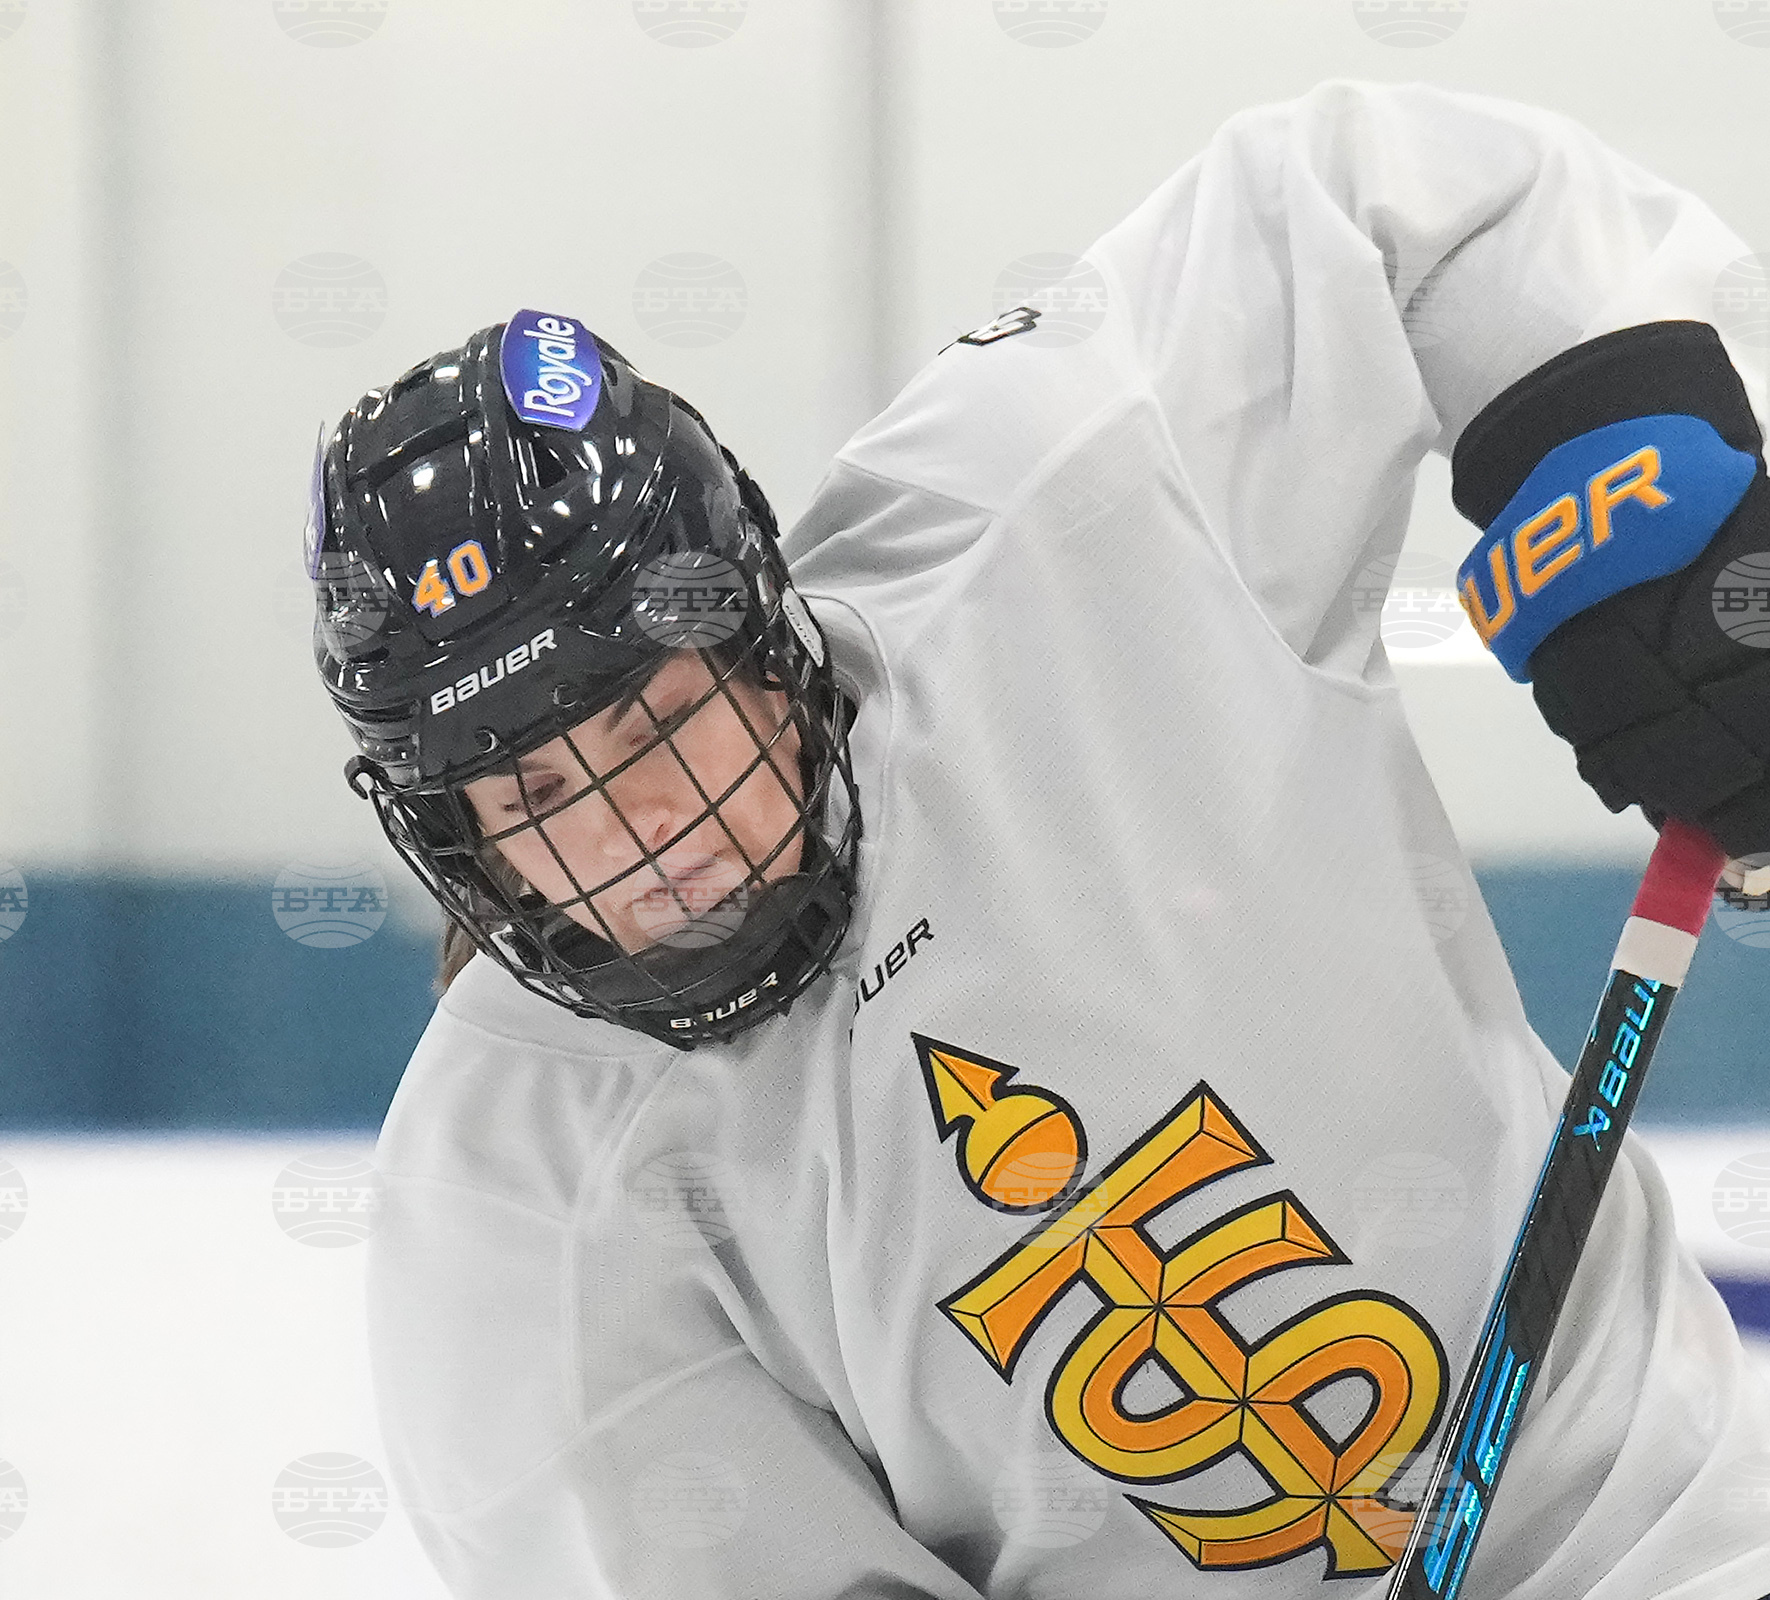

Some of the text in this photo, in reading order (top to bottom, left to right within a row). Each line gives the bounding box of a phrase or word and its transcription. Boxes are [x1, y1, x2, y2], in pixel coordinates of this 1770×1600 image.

[523, 315, 594, 418] Royale
[411, 539, 493, 619] 40
[1459, 444, 1674, 651] UER
[430, 627, 558, 716] BAUER
[855, 917, 934, 1018] UER
